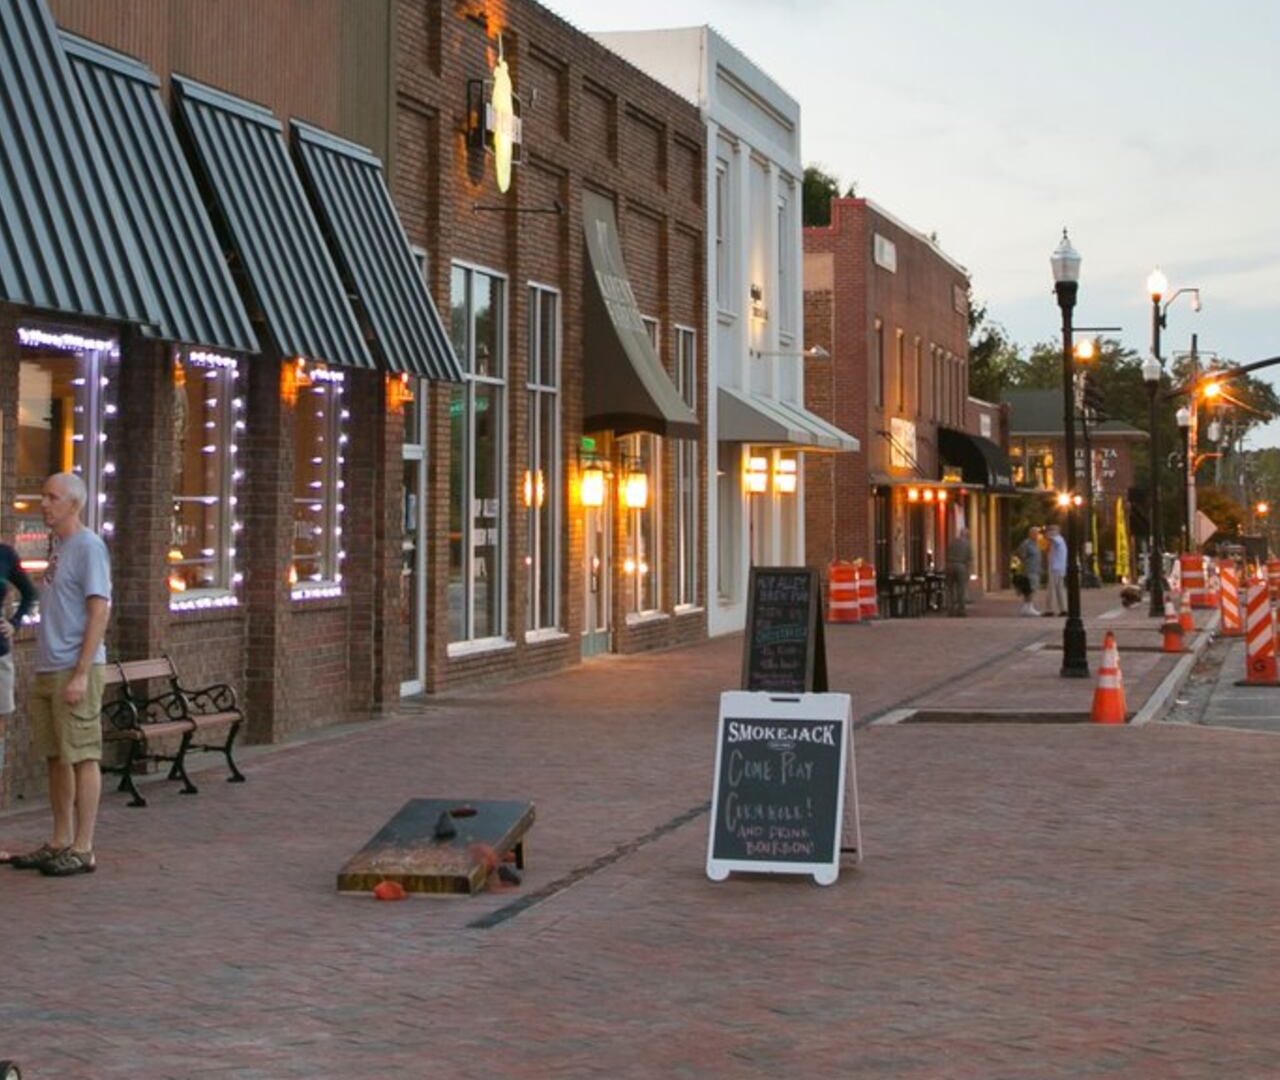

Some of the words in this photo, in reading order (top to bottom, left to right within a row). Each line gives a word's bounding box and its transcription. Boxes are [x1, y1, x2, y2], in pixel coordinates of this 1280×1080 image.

[727, 721, 835, 745] SMOKEJACK
[727, 748, 772, 787] COME
[779, 750, 815, 785] PLAY
